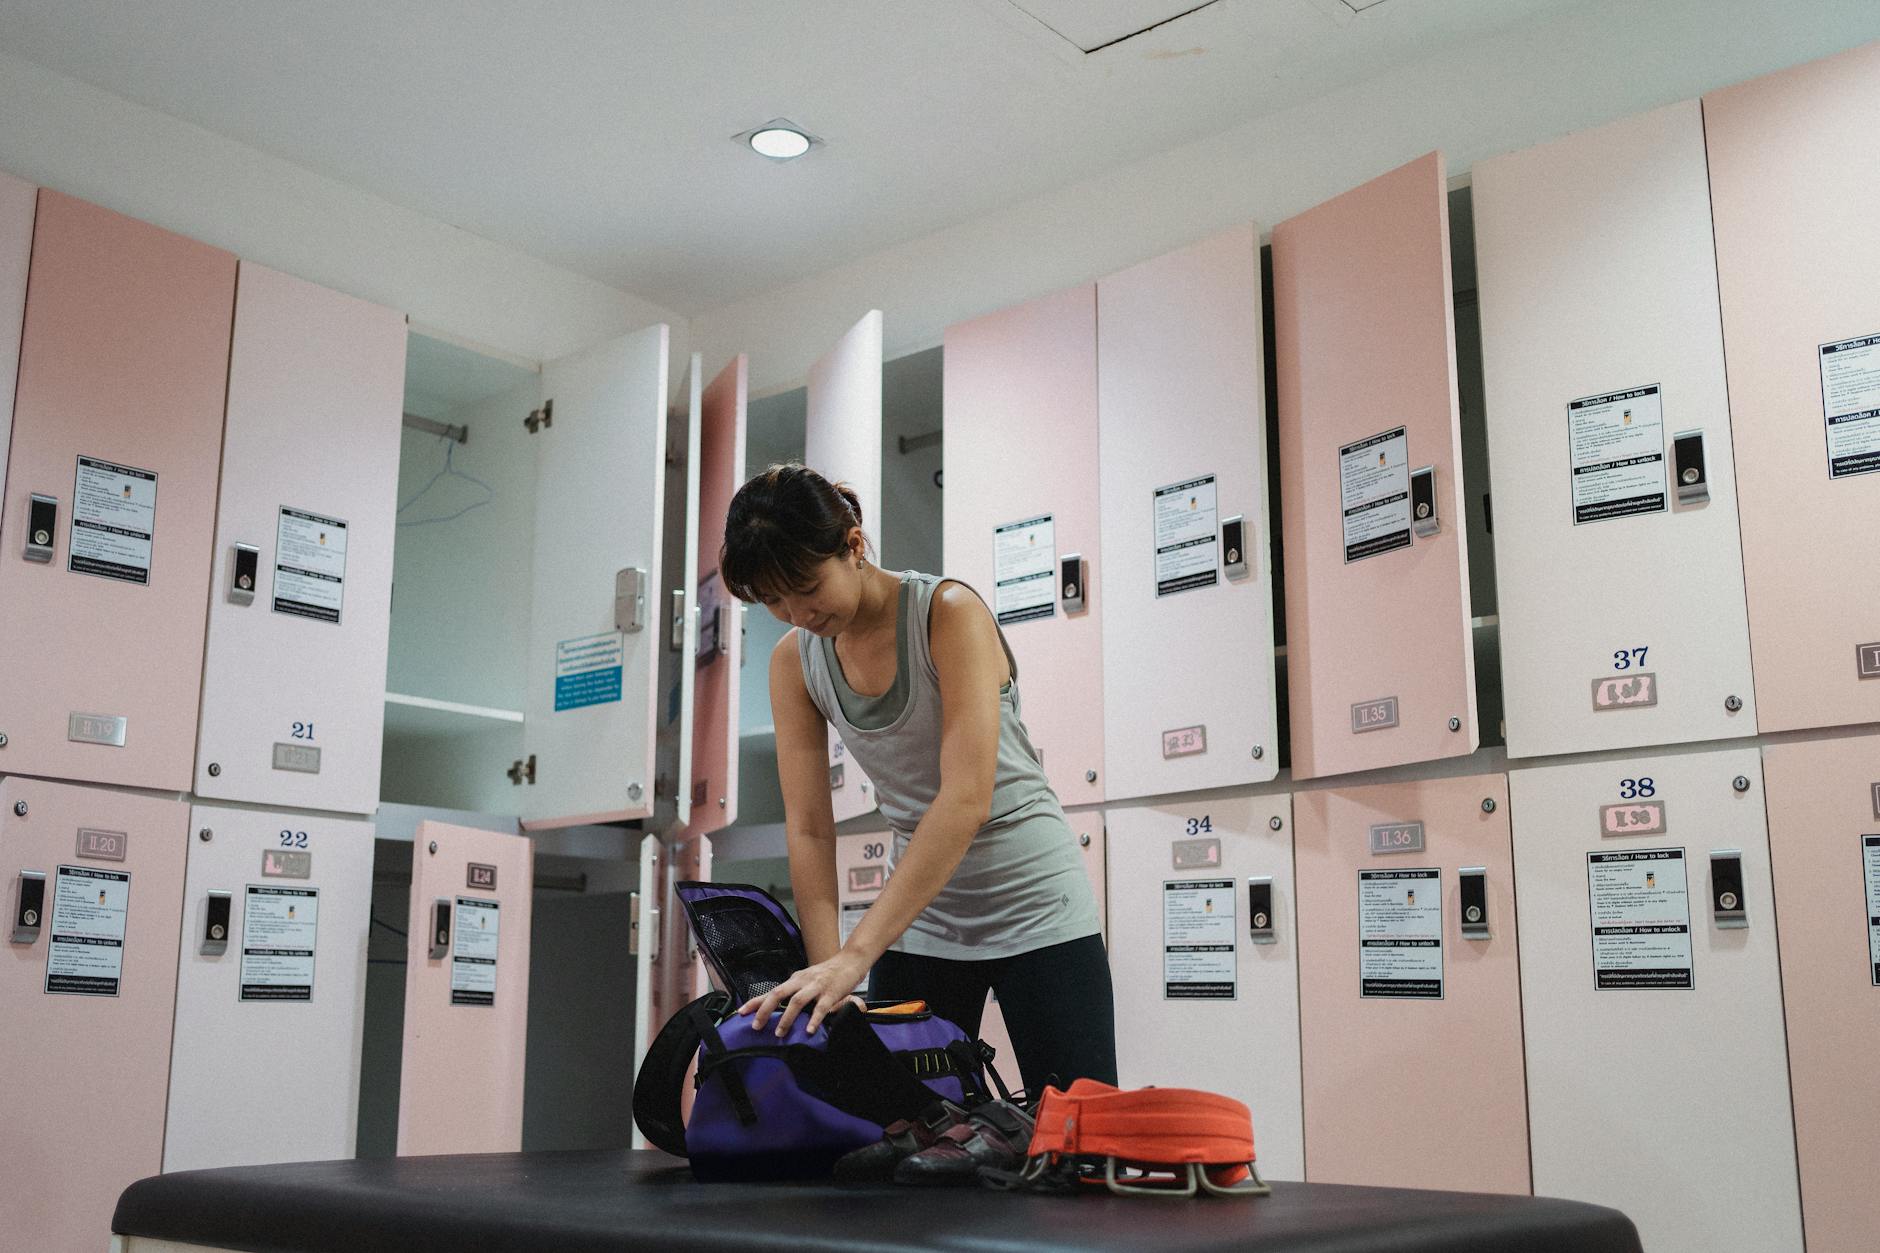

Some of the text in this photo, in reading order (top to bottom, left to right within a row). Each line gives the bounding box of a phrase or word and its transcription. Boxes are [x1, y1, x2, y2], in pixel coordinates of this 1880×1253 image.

[1614, 646, 1648, 670] 37
[1360, 706, 1386, 723] II.35
[292, 722, 314, 740] 21
[1620, 778, 1655, 799] 38
[1186, 816, 1212, 836] 34
[90, 836, 116, 852] II.20
[280, 830, 308, 848] 22
[1382, 830, 1411, 846] II.36
[864, 843, 884, 860] 30
